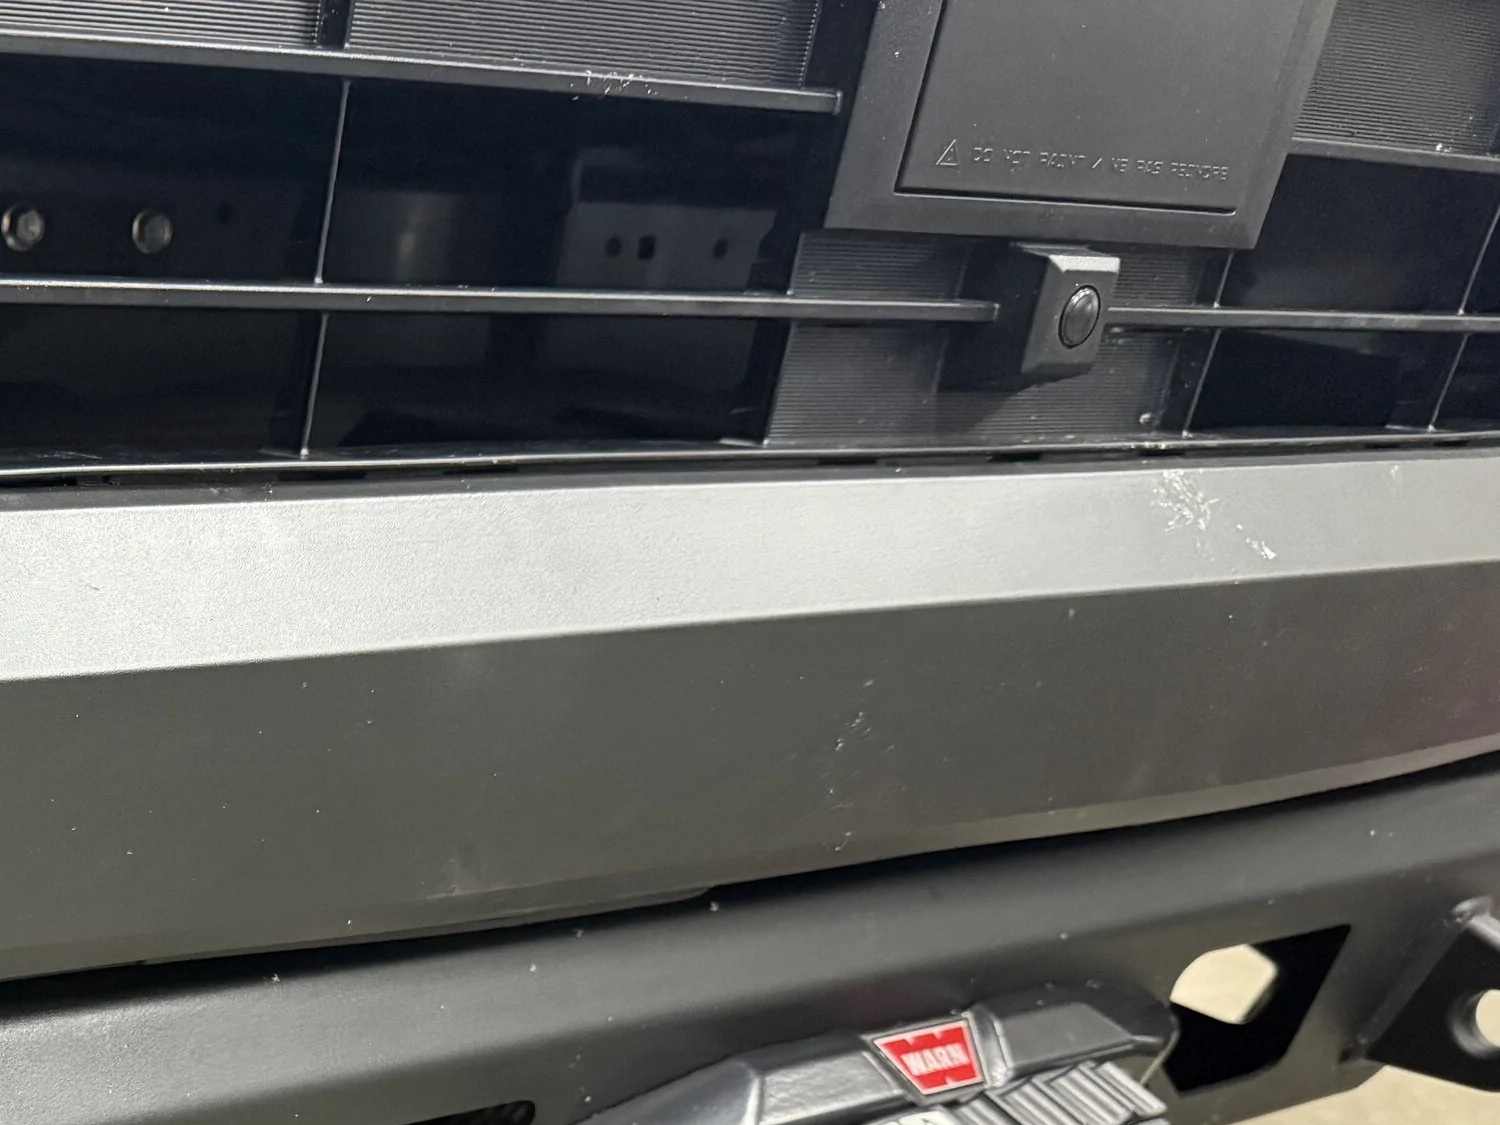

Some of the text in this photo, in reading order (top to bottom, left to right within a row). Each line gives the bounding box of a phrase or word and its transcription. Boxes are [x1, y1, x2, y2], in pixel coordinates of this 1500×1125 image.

[972, 146, 994, 162] DO
[1002, 148, 1031, 165] NOT
[1039, 151, 1086, 169] PAINT
[1136, 159, 1164, 175] PAS
[900, 1041, 972, 1078] WARN
